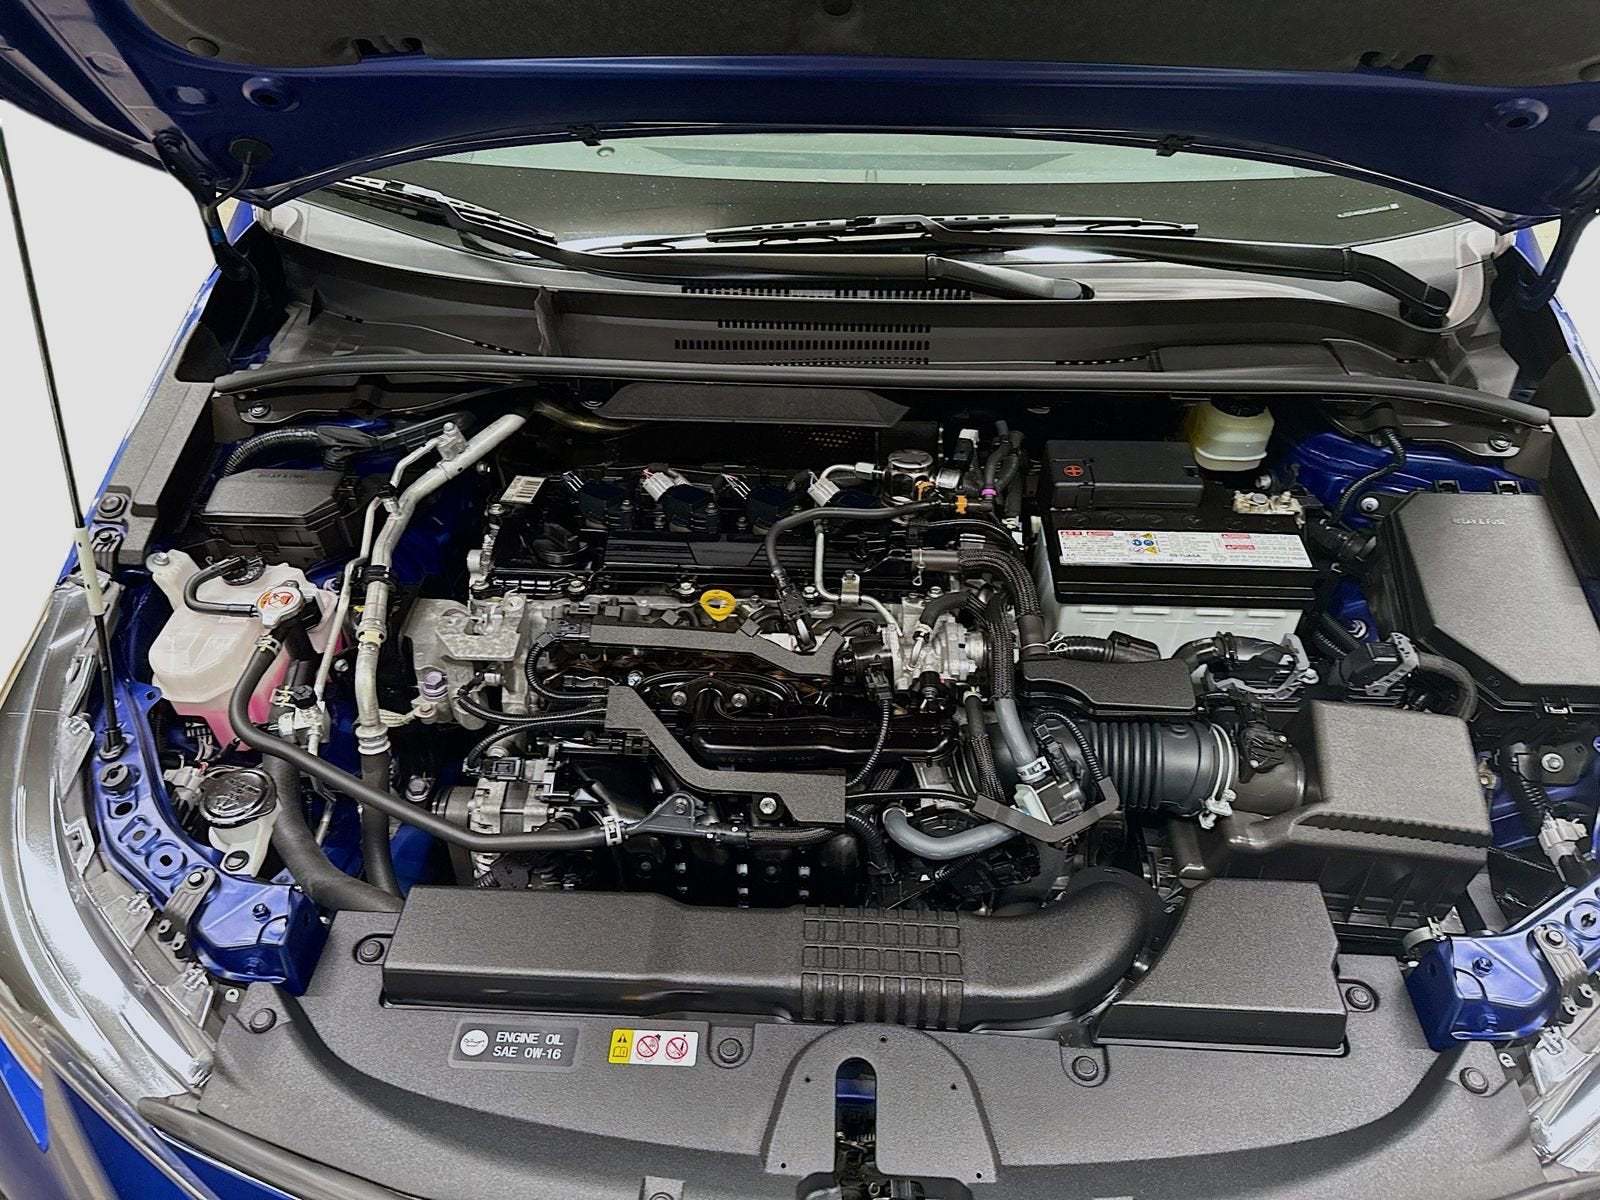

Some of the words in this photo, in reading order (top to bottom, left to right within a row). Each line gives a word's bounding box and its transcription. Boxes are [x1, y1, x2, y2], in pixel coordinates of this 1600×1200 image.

[495, 1031, 540, 1045] ENGINE
[545, 1033, 564, 1046] OIL
[492, 1046, 518, 1058] SAE
[524, 1047, 562, 1059] 0W-16
